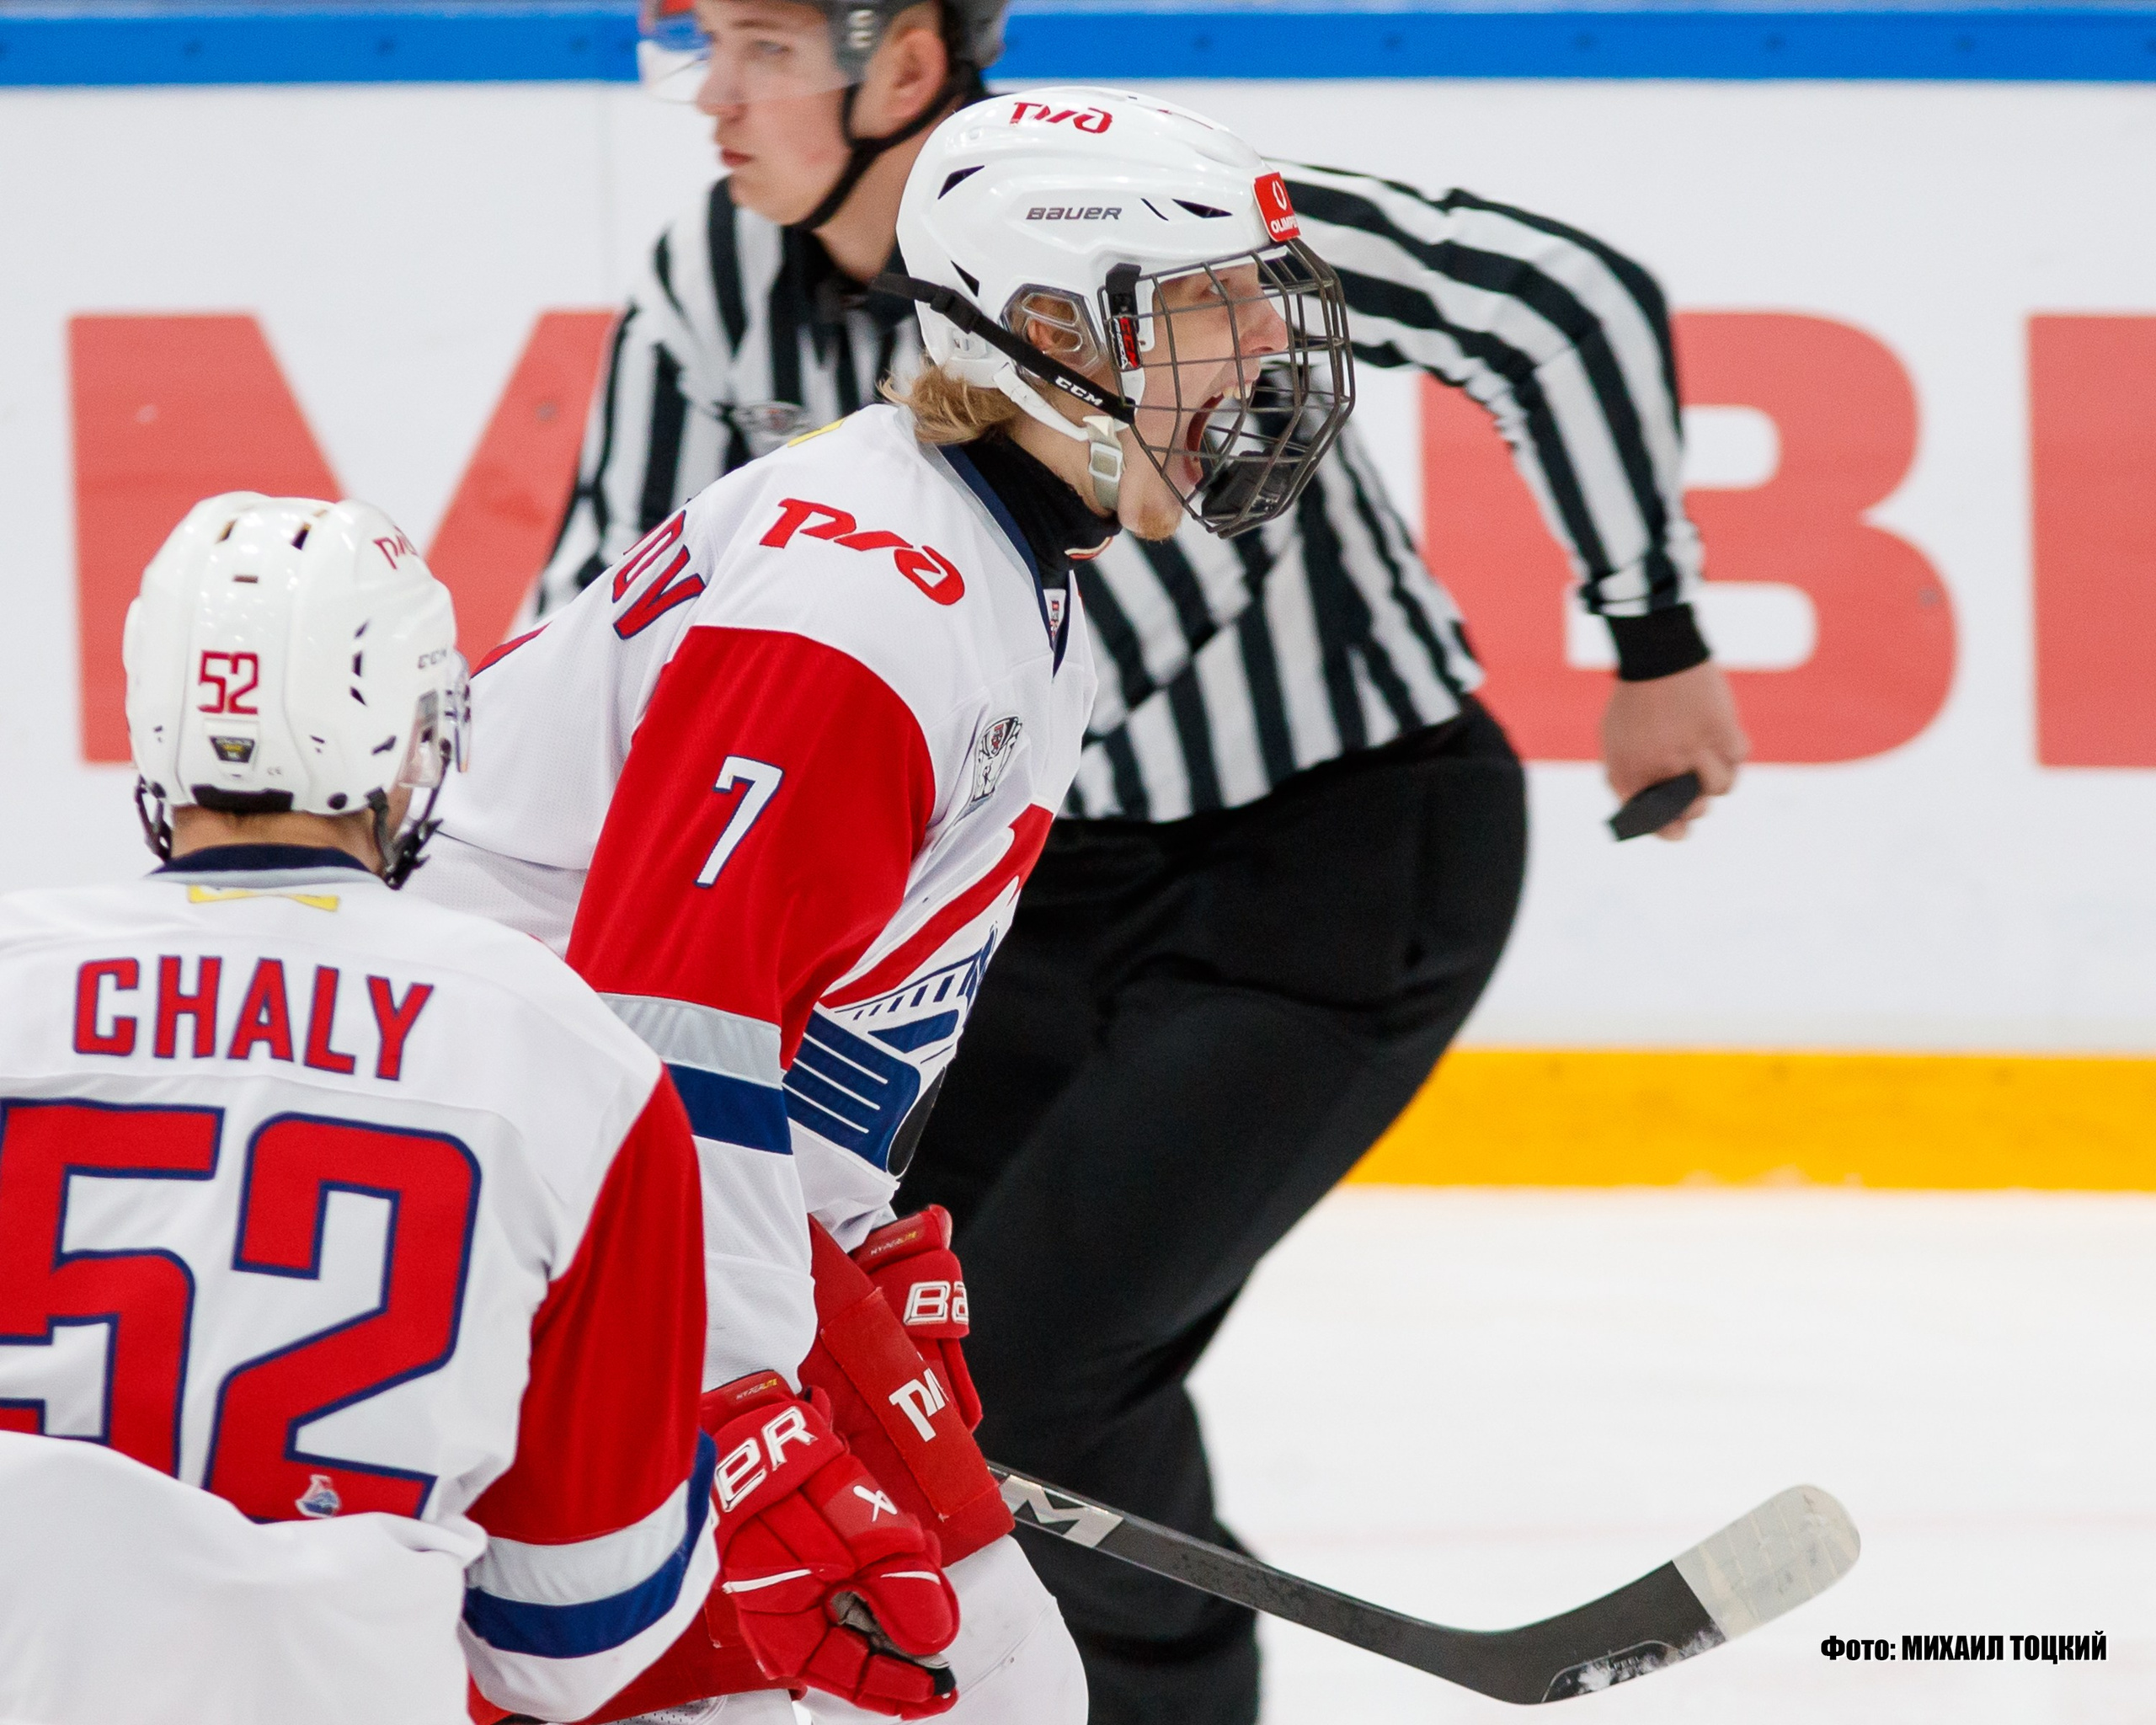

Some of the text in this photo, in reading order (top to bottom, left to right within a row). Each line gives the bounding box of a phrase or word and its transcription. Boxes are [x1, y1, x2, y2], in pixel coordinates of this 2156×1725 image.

[1026, 206, 1122, 221] BAUER
[1055, 376, 1102, 407] CCM
[198, 650, 259, 714] 52
[692, 755, 785, 889] 7
[72, 953, 435, 1081] CHALY
[0, 1097, 482, 1521] 52
